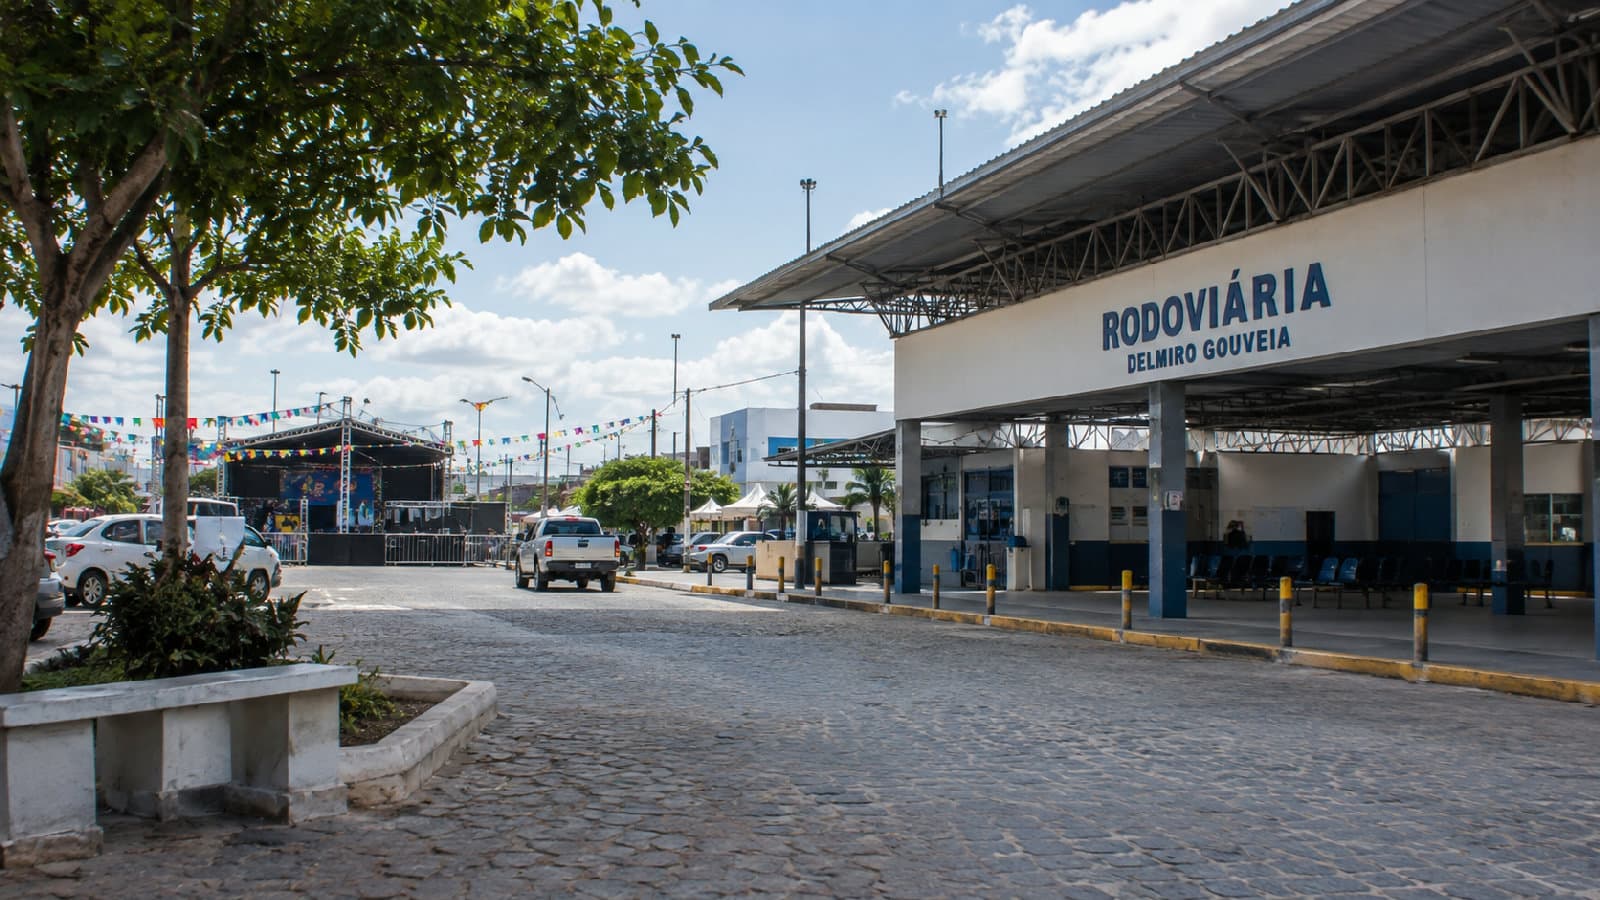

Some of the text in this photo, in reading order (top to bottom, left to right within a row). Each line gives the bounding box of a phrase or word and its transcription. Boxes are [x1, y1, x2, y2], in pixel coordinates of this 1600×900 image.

[1102, 262, 1331, 351] RODOVIÁRIA
[1127, 326, 1291, 374] DELMIRO GOUVEIA
